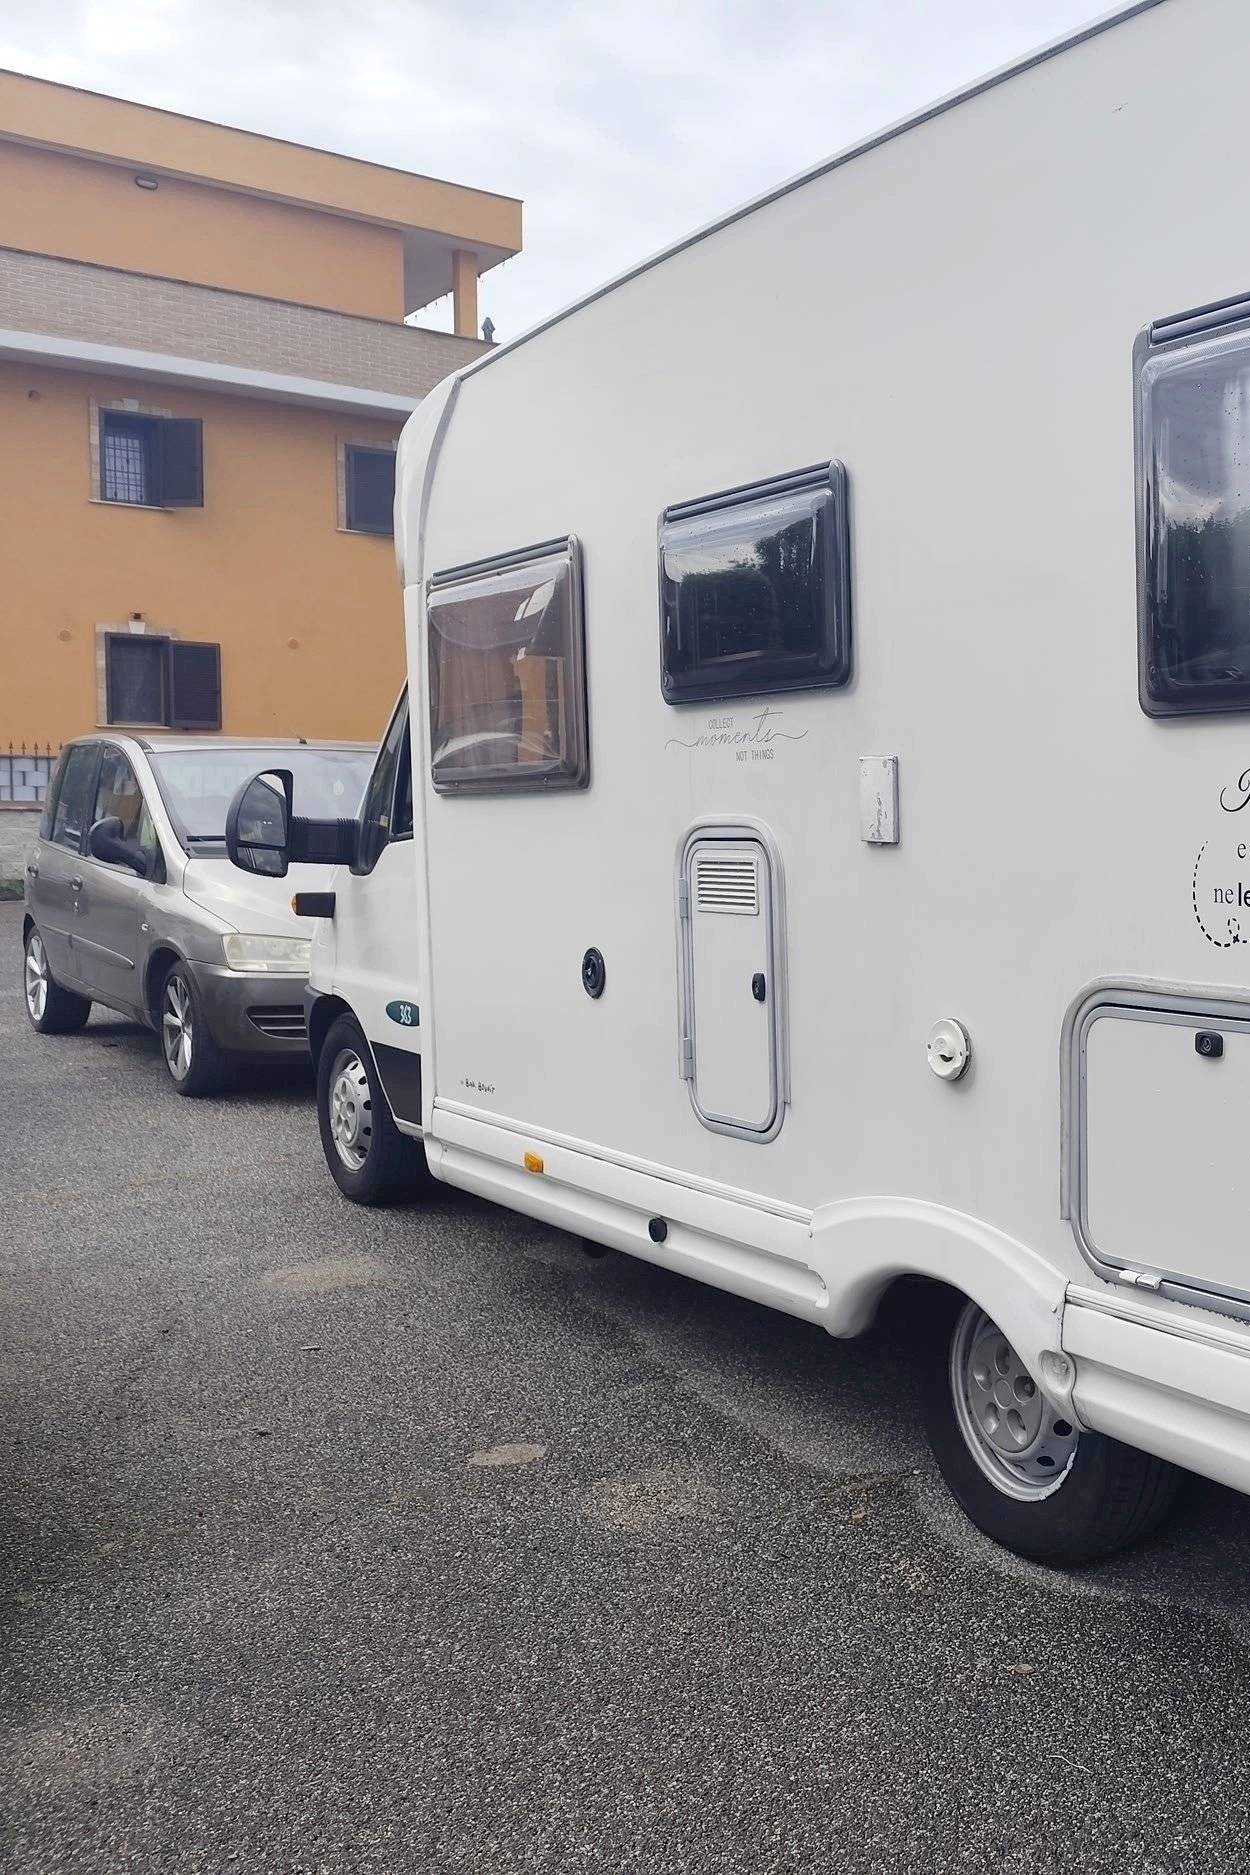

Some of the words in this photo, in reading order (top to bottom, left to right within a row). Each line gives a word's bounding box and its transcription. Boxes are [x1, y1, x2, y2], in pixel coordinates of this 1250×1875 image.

[665, 707, 809, 751] moments
[708, 717, 734, 730] COLLECT
[736, 751, 747, 762] NOT
[751, 749, 775, 761] THINGS
[1237, 843, 1246, 859] e
[1213, 886, 1234, 905] ne
